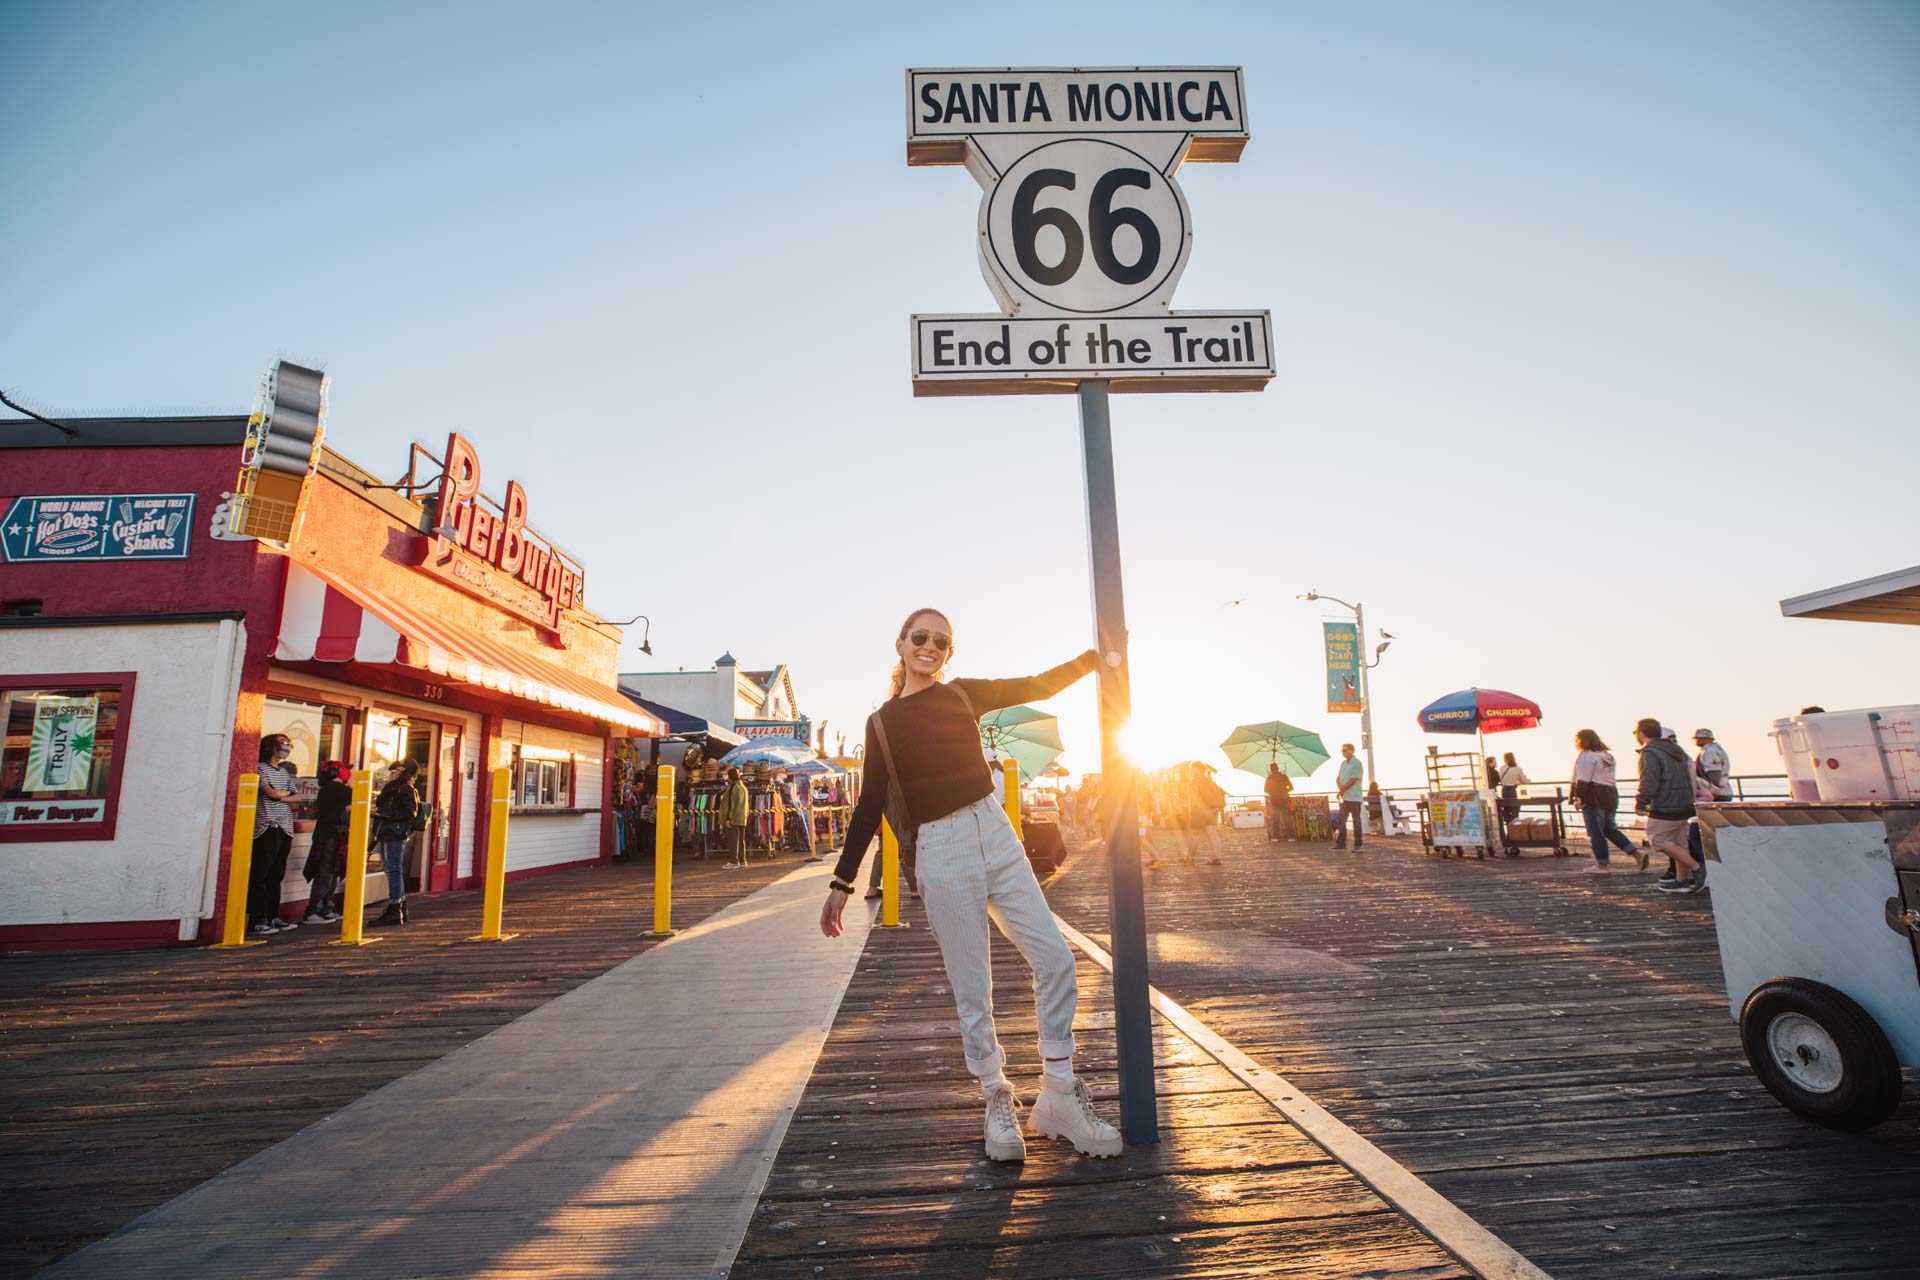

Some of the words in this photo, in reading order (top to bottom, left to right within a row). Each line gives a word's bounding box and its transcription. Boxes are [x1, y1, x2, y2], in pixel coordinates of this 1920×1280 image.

[920, 81, 1053, 125] SANTA
[1066, 80, 1234, 123] MONICA
[1010, 167, 1162, 287] 66
[932, 324, 1012, 367] End
[1027, 322, 1071, 366] of
[1085, 322, 1152, 365] the
[1163, 321, 1256, 363] Trail
[39, 501, 70, 513] WORLD
[69, 500, 106, 512] FAMOUS
[35, 516, 63, 546] Hot
[62, 512, 99, 530] Dogs
[112, 514, 167, 542] Custard
[123, 534, 176, 555] Shakes
[1328, 652, 1354, 660] START
[423, 685, 443, 700] 330
[39, 706, 59, 717] NOW
[60, 705, 95, 717] SERVING
[1428, 710, 1470, 721] CHURROS
[1486, 708, 1532, 717] CHURROS
[737, 726, 793, 736] PLAYLAND
[50, 727, 68, 771] TRULY
[13, 806, 45, 821] Pier
[46, 806, 99, 822] Burger
